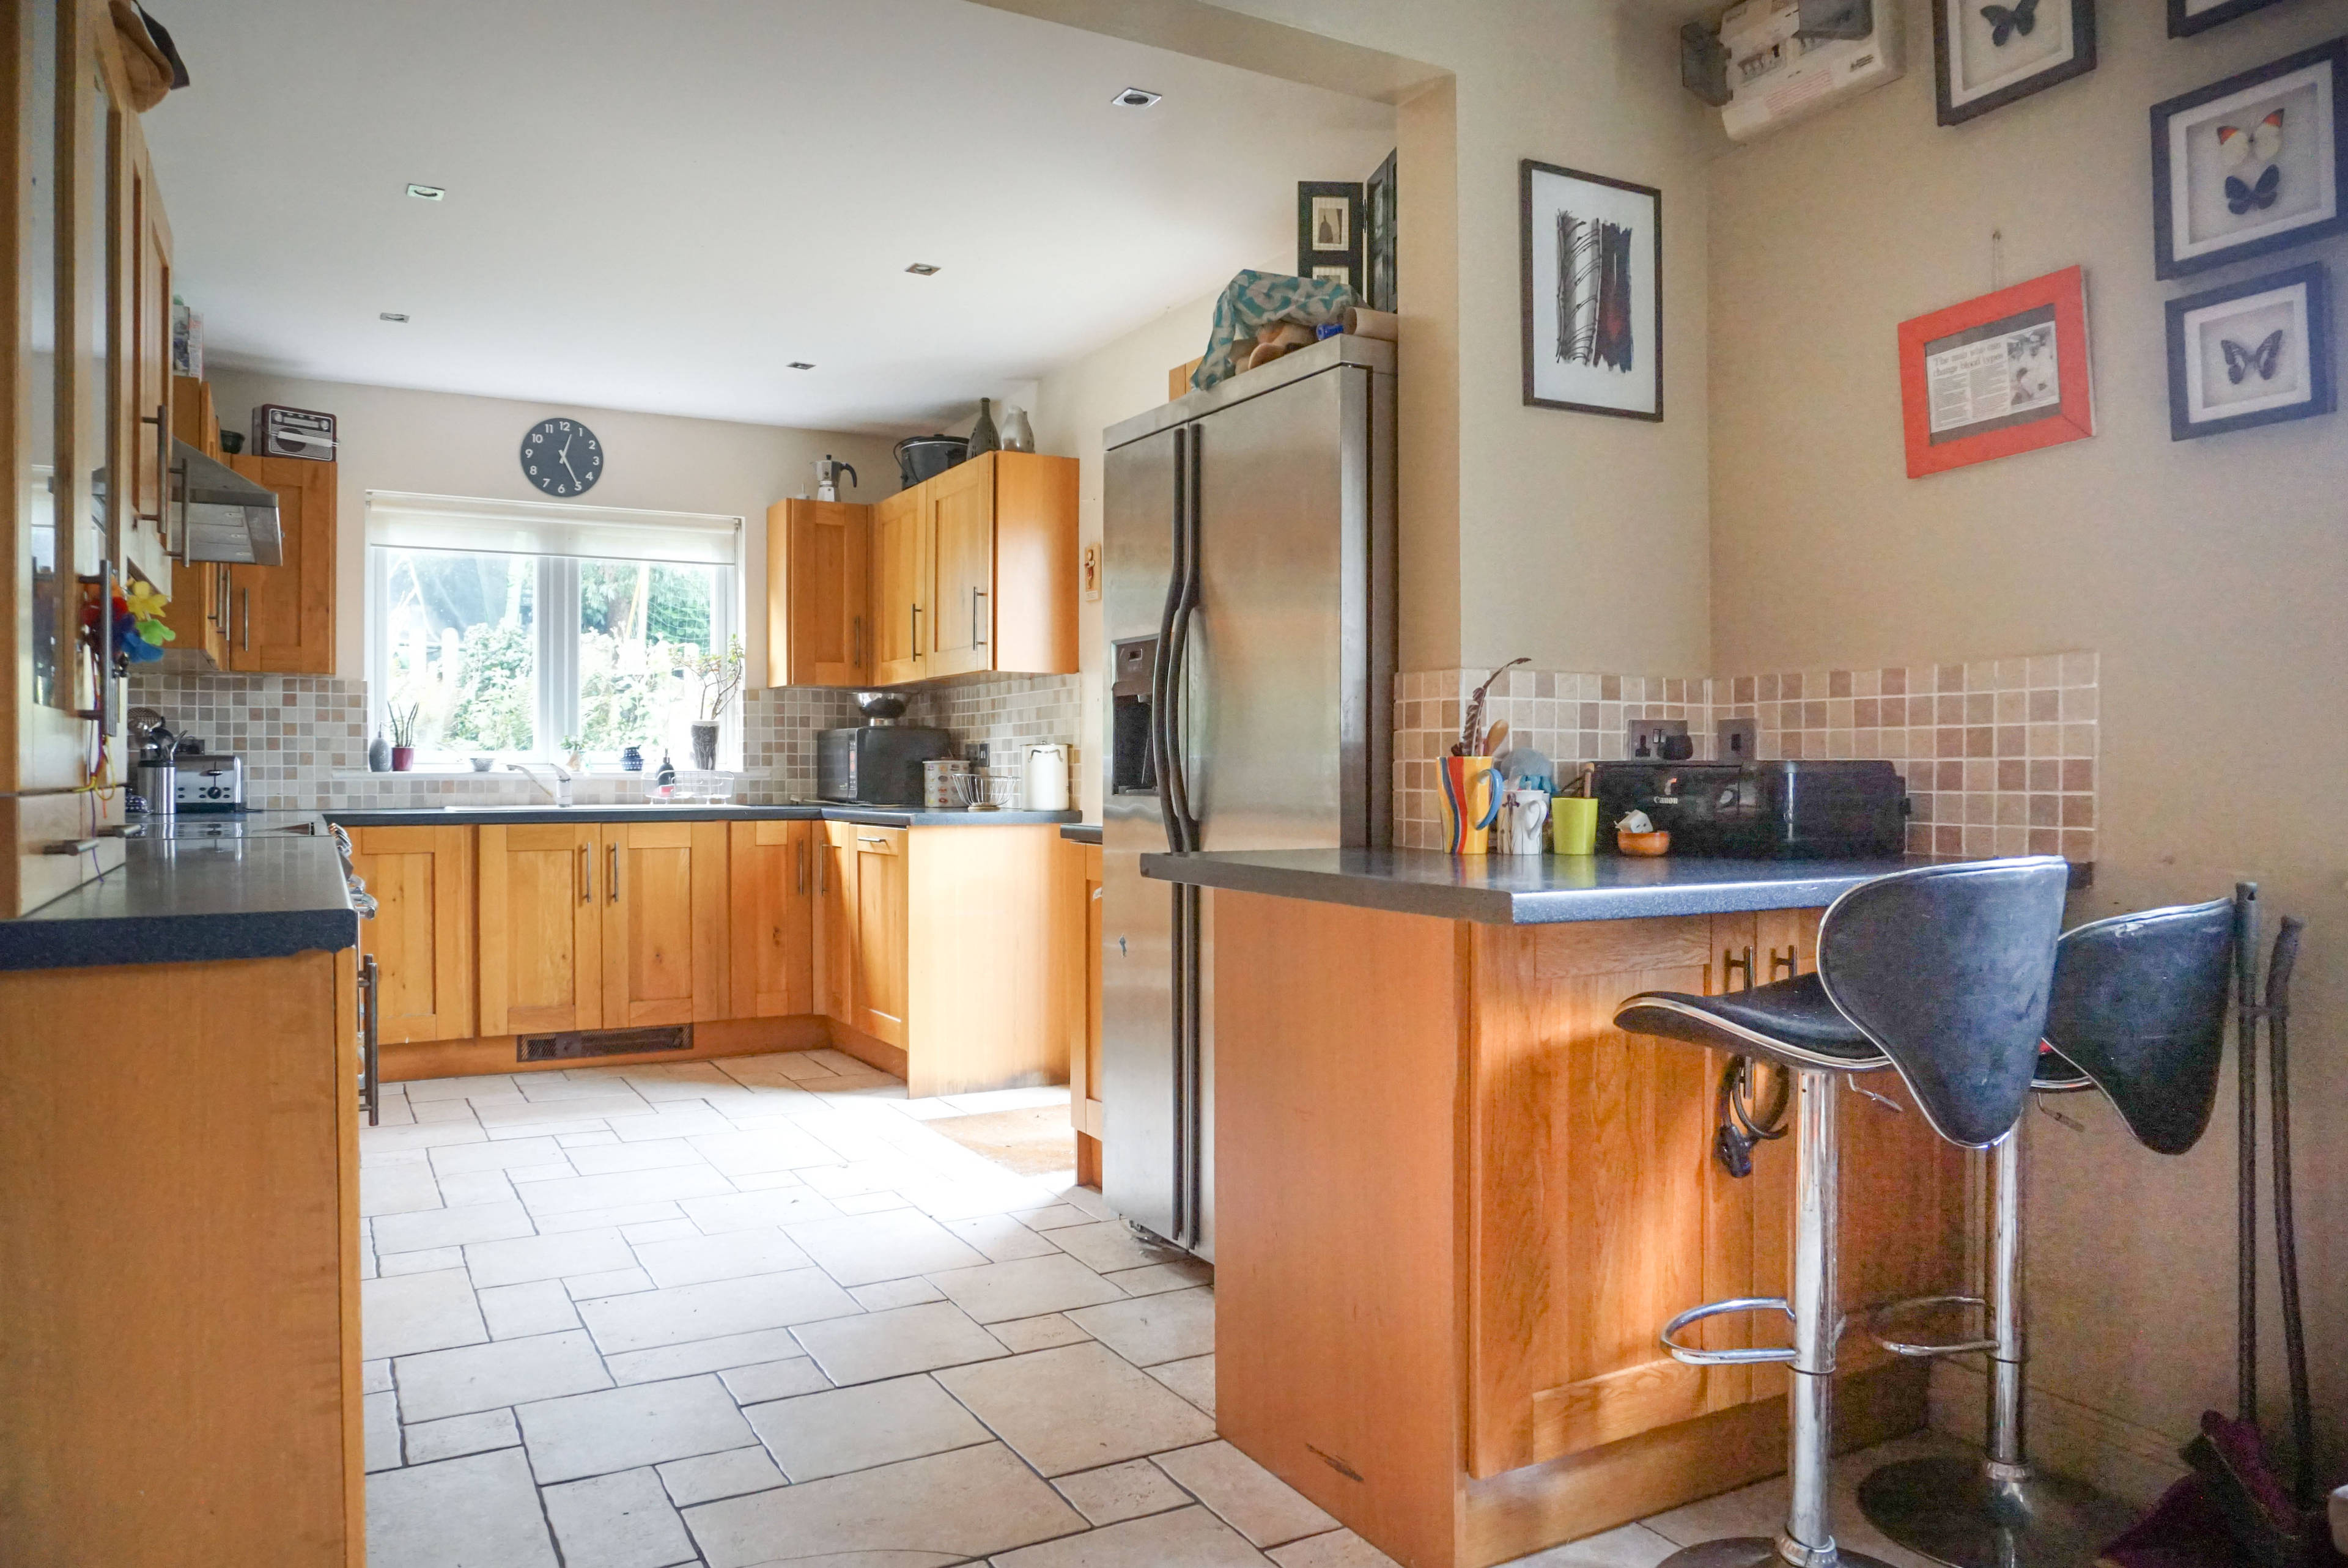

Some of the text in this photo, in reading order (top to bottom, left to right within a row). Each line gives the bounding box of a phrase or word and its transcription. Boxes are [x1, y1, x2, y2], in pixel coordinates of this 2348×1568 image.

[545, 424, 553, 433] 11
[559, 421, 570, 432] 12
[578, 428, 583, 436] 1
[532, 433, 543, 443] 10
[588, 440, 596, 449] 2
[525, 449, 533, 458] 9
[593, 456, 599, 465] 3
[530, 466, 537, 475] 8
[585, 471, 593, 480] 4
[543, 478, 550, 487] 7
[574, 481, 582, 491] 5
[558, 484, 565, 493] 6
[1653, 796, 1678, 804] Canon
